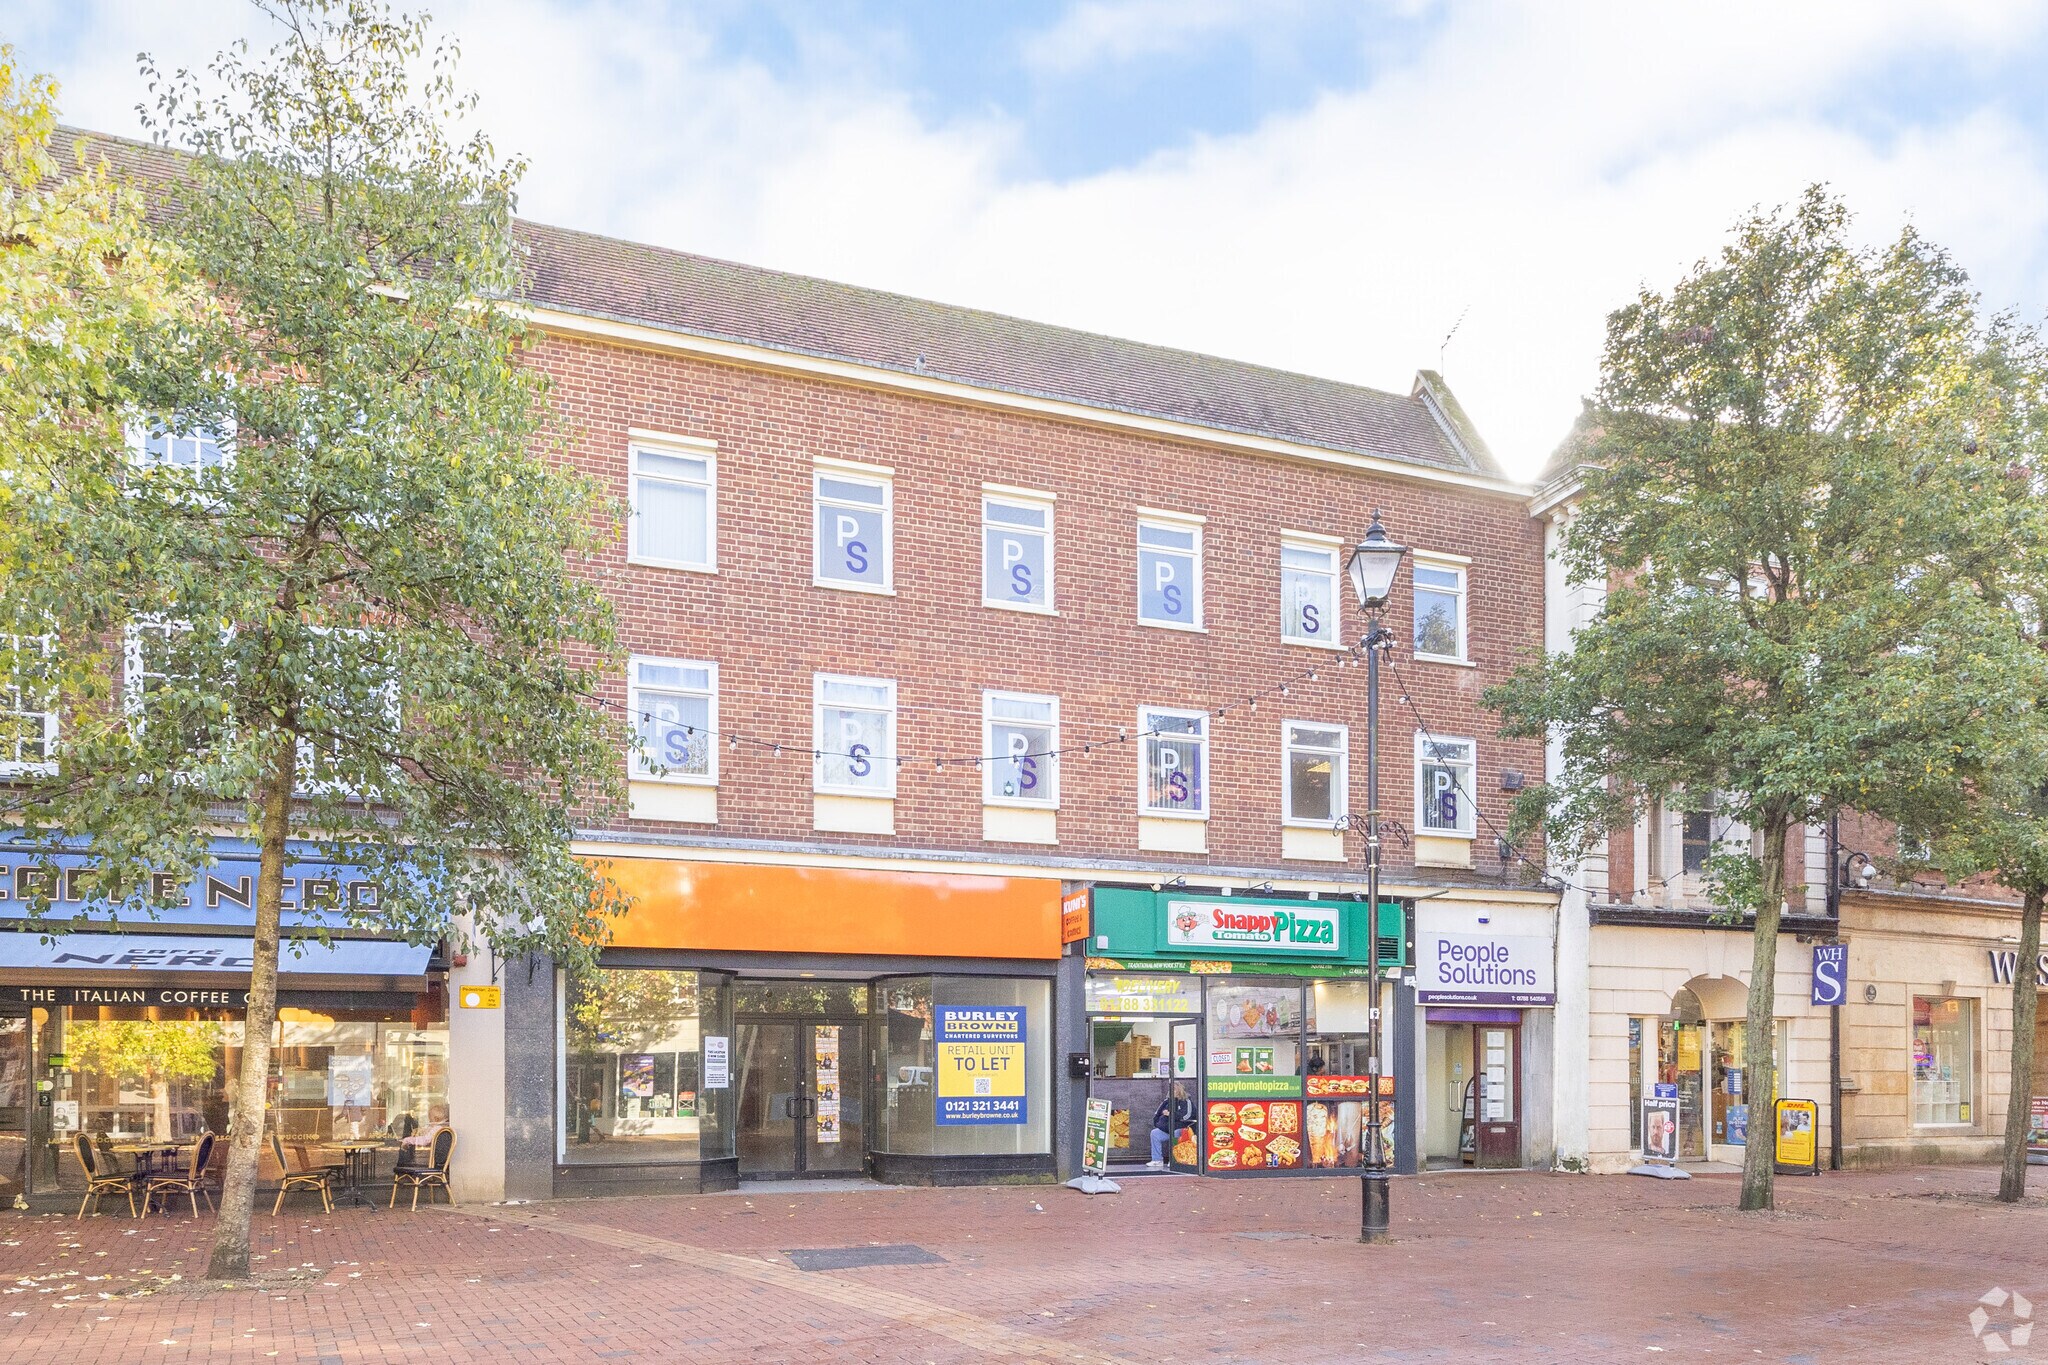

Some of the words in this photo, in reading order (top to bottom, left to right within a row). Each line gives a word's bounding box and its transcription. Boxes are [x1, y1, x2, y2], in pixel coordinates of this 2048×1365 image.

[1212, 908, 1279, 934] Snappy
[1274, 911, 1334, 944] Pizza
[1214, 930, 1269, 941] Tomato
[1438, 939, 1509, 968] People
[1816, 947, 1843, 961] WH
[1438, 961, 1536, 986] Solutions
[20, 989, 56, 1002] THE
[75, 990, 146, 1002] ITALIAN
[160, 991, 229, 1004] COFFEE
[944, 1011, 1019, 1021] BURLEY
[946, 1022, 1017, 1030] BROWNE
[947, 1045, 986, 1055] RETAIL
[989, 1045, 1016, 1055] UNIT
[1212, 1054, 1231, 1062] CLOSED
[953, 1057, 976, 1071] TO
[981, 1057, 1011, 1071] LET
[945, 1101, 970, 1111] 0121
[972, 1101, 991, 1111] 321
[993, 1100, 1019, 1110] 3441
[1644, 1099, 1658, 1107] Half
[1658, 1100, 1676, 1109] price
[945, 1112, 1018, 1120] www.burleybrowne.co.uk
